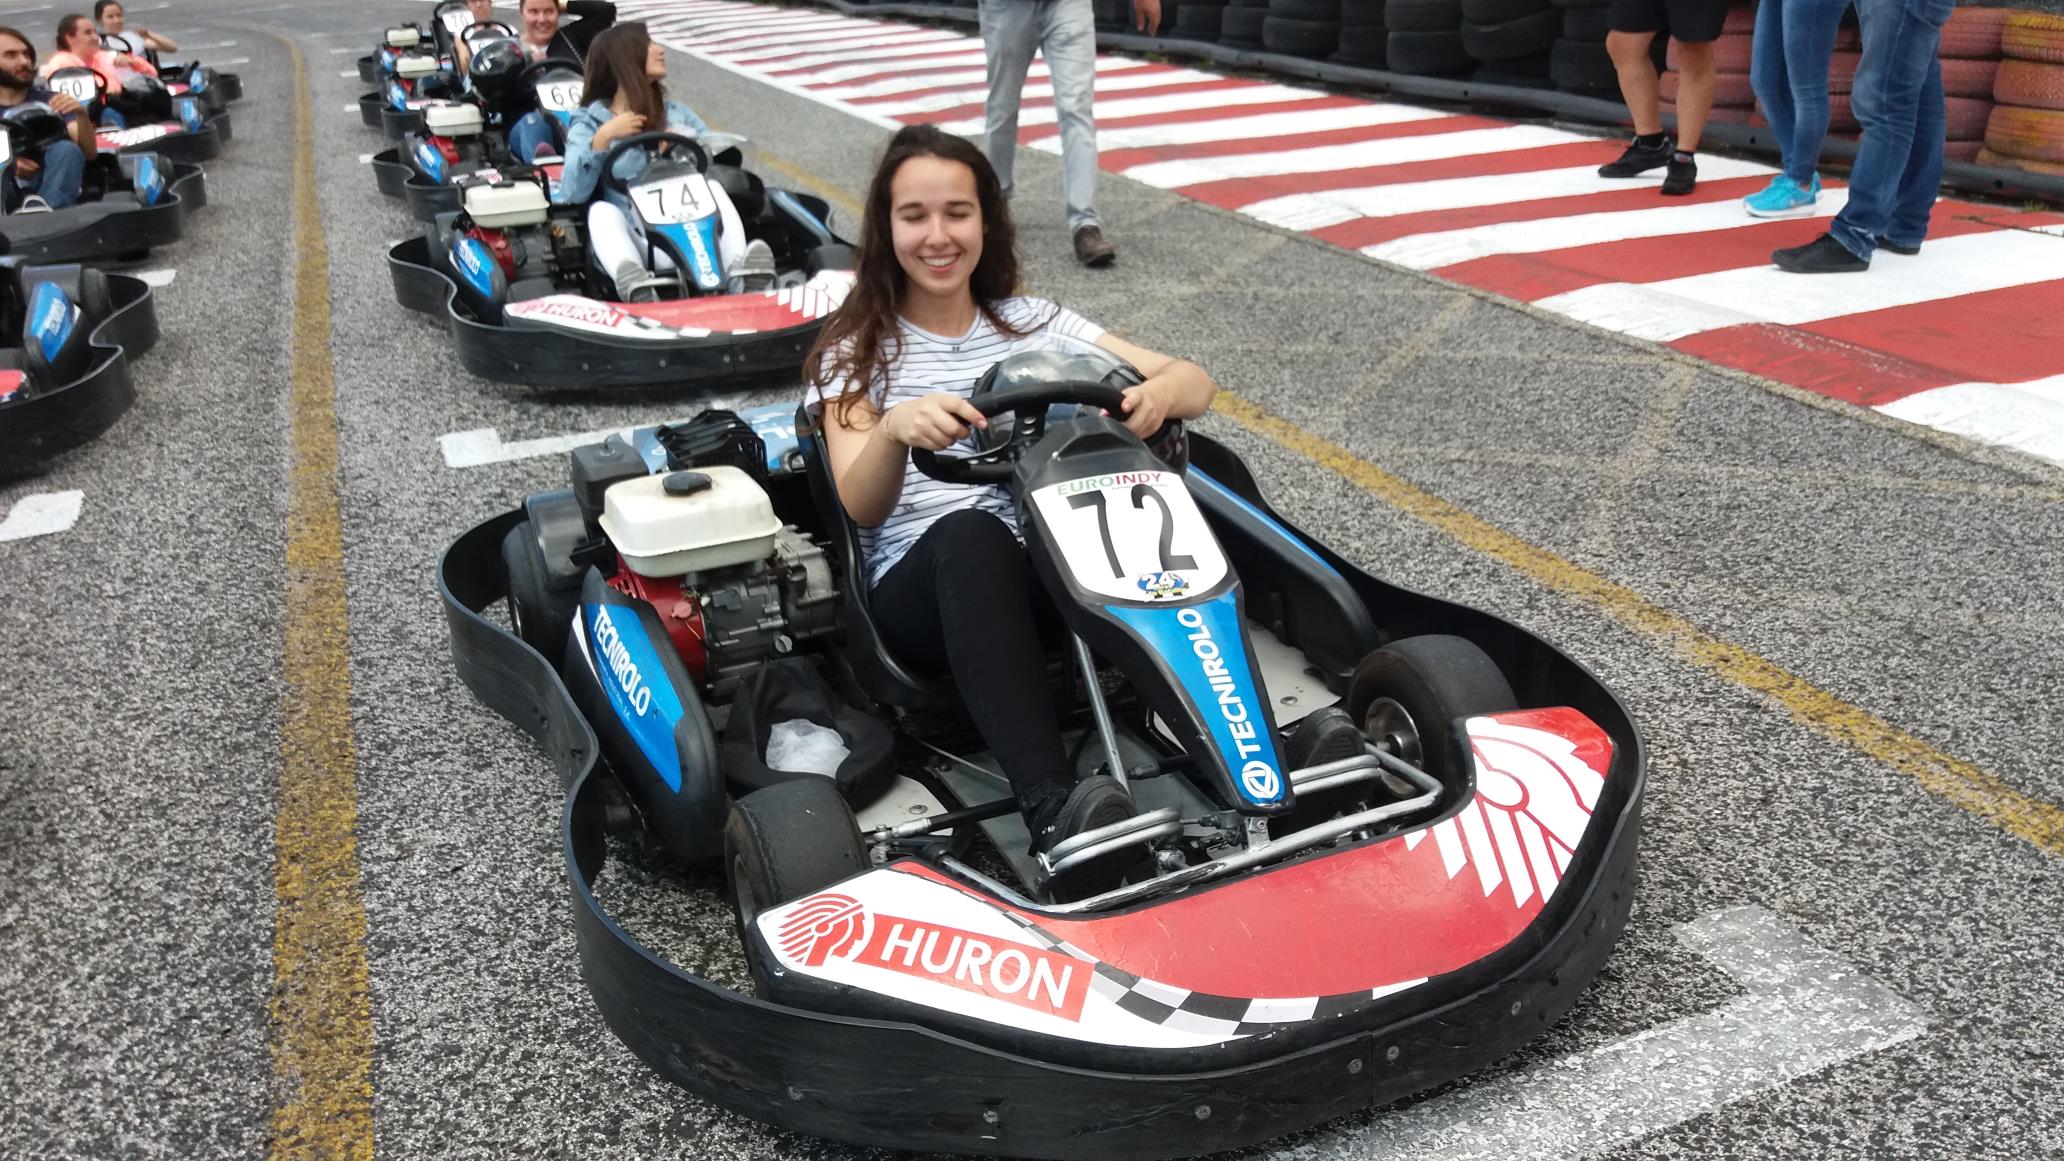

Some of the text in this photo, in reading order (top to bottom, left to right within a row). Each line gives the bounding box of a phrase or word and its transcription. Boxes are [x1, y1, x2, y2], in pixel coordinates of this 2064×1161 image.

[551, 85, 581, 106] 66
[647, 183, 699, 216] 74
[1057, 473, 1161, 495] EUROINDY
[1066, 484, 1199, 579] 72
[1141, 571, 1176, 590] 24
[594, 604, 651, 717] TECNIROLO
[1177, 608, 1261, 760] TECNIROLO
[880, 923, 1073, 1009] HURON
